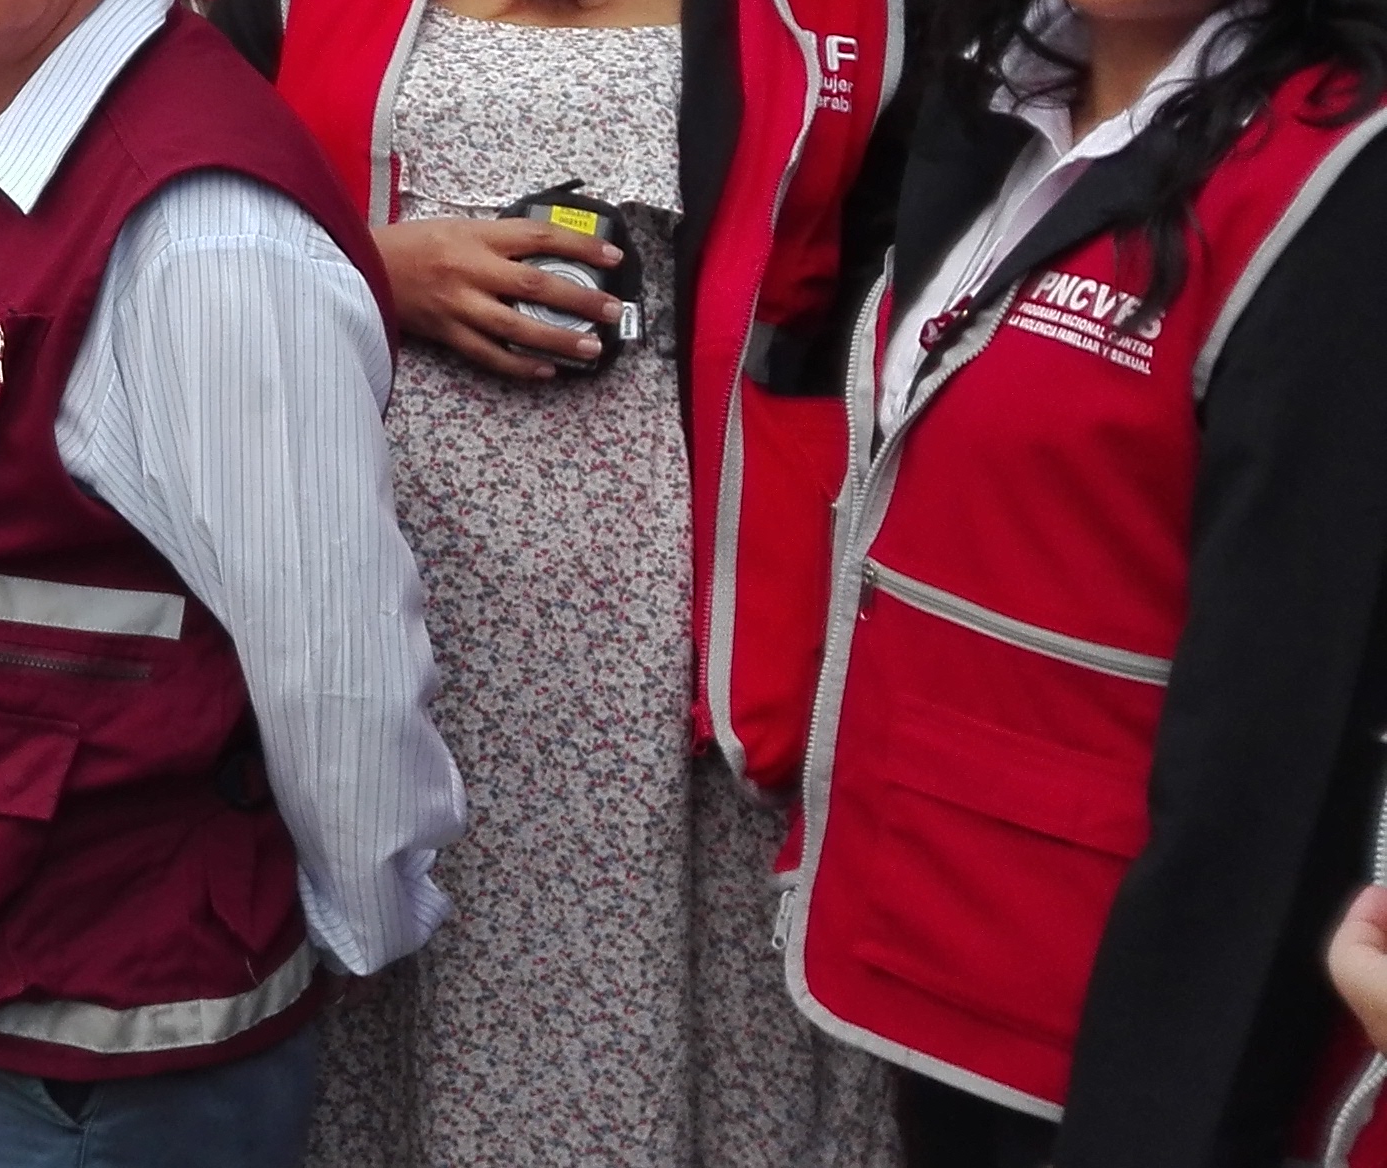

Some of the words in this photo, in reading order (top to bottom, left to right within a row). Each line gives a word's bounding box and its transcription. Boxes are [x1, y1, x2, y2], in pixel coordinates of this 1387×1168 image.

[824, 74, 854, 94] ujer
[1008, 314, 1020, 326] LA
[1019, 315, 1059, 339] VIOLENCIA
[1056, 324, 1101, 354] FAMILIAR
[1101, 343, 1111, 357] Y
[1110, 348, 1152, 375] SEXUAL
[1019, 301, 1062, 323] PROGRAMA
[1059, 309, 1107, 340] NACIONAL
[1107, 329, 1155, 358] CNTRA
